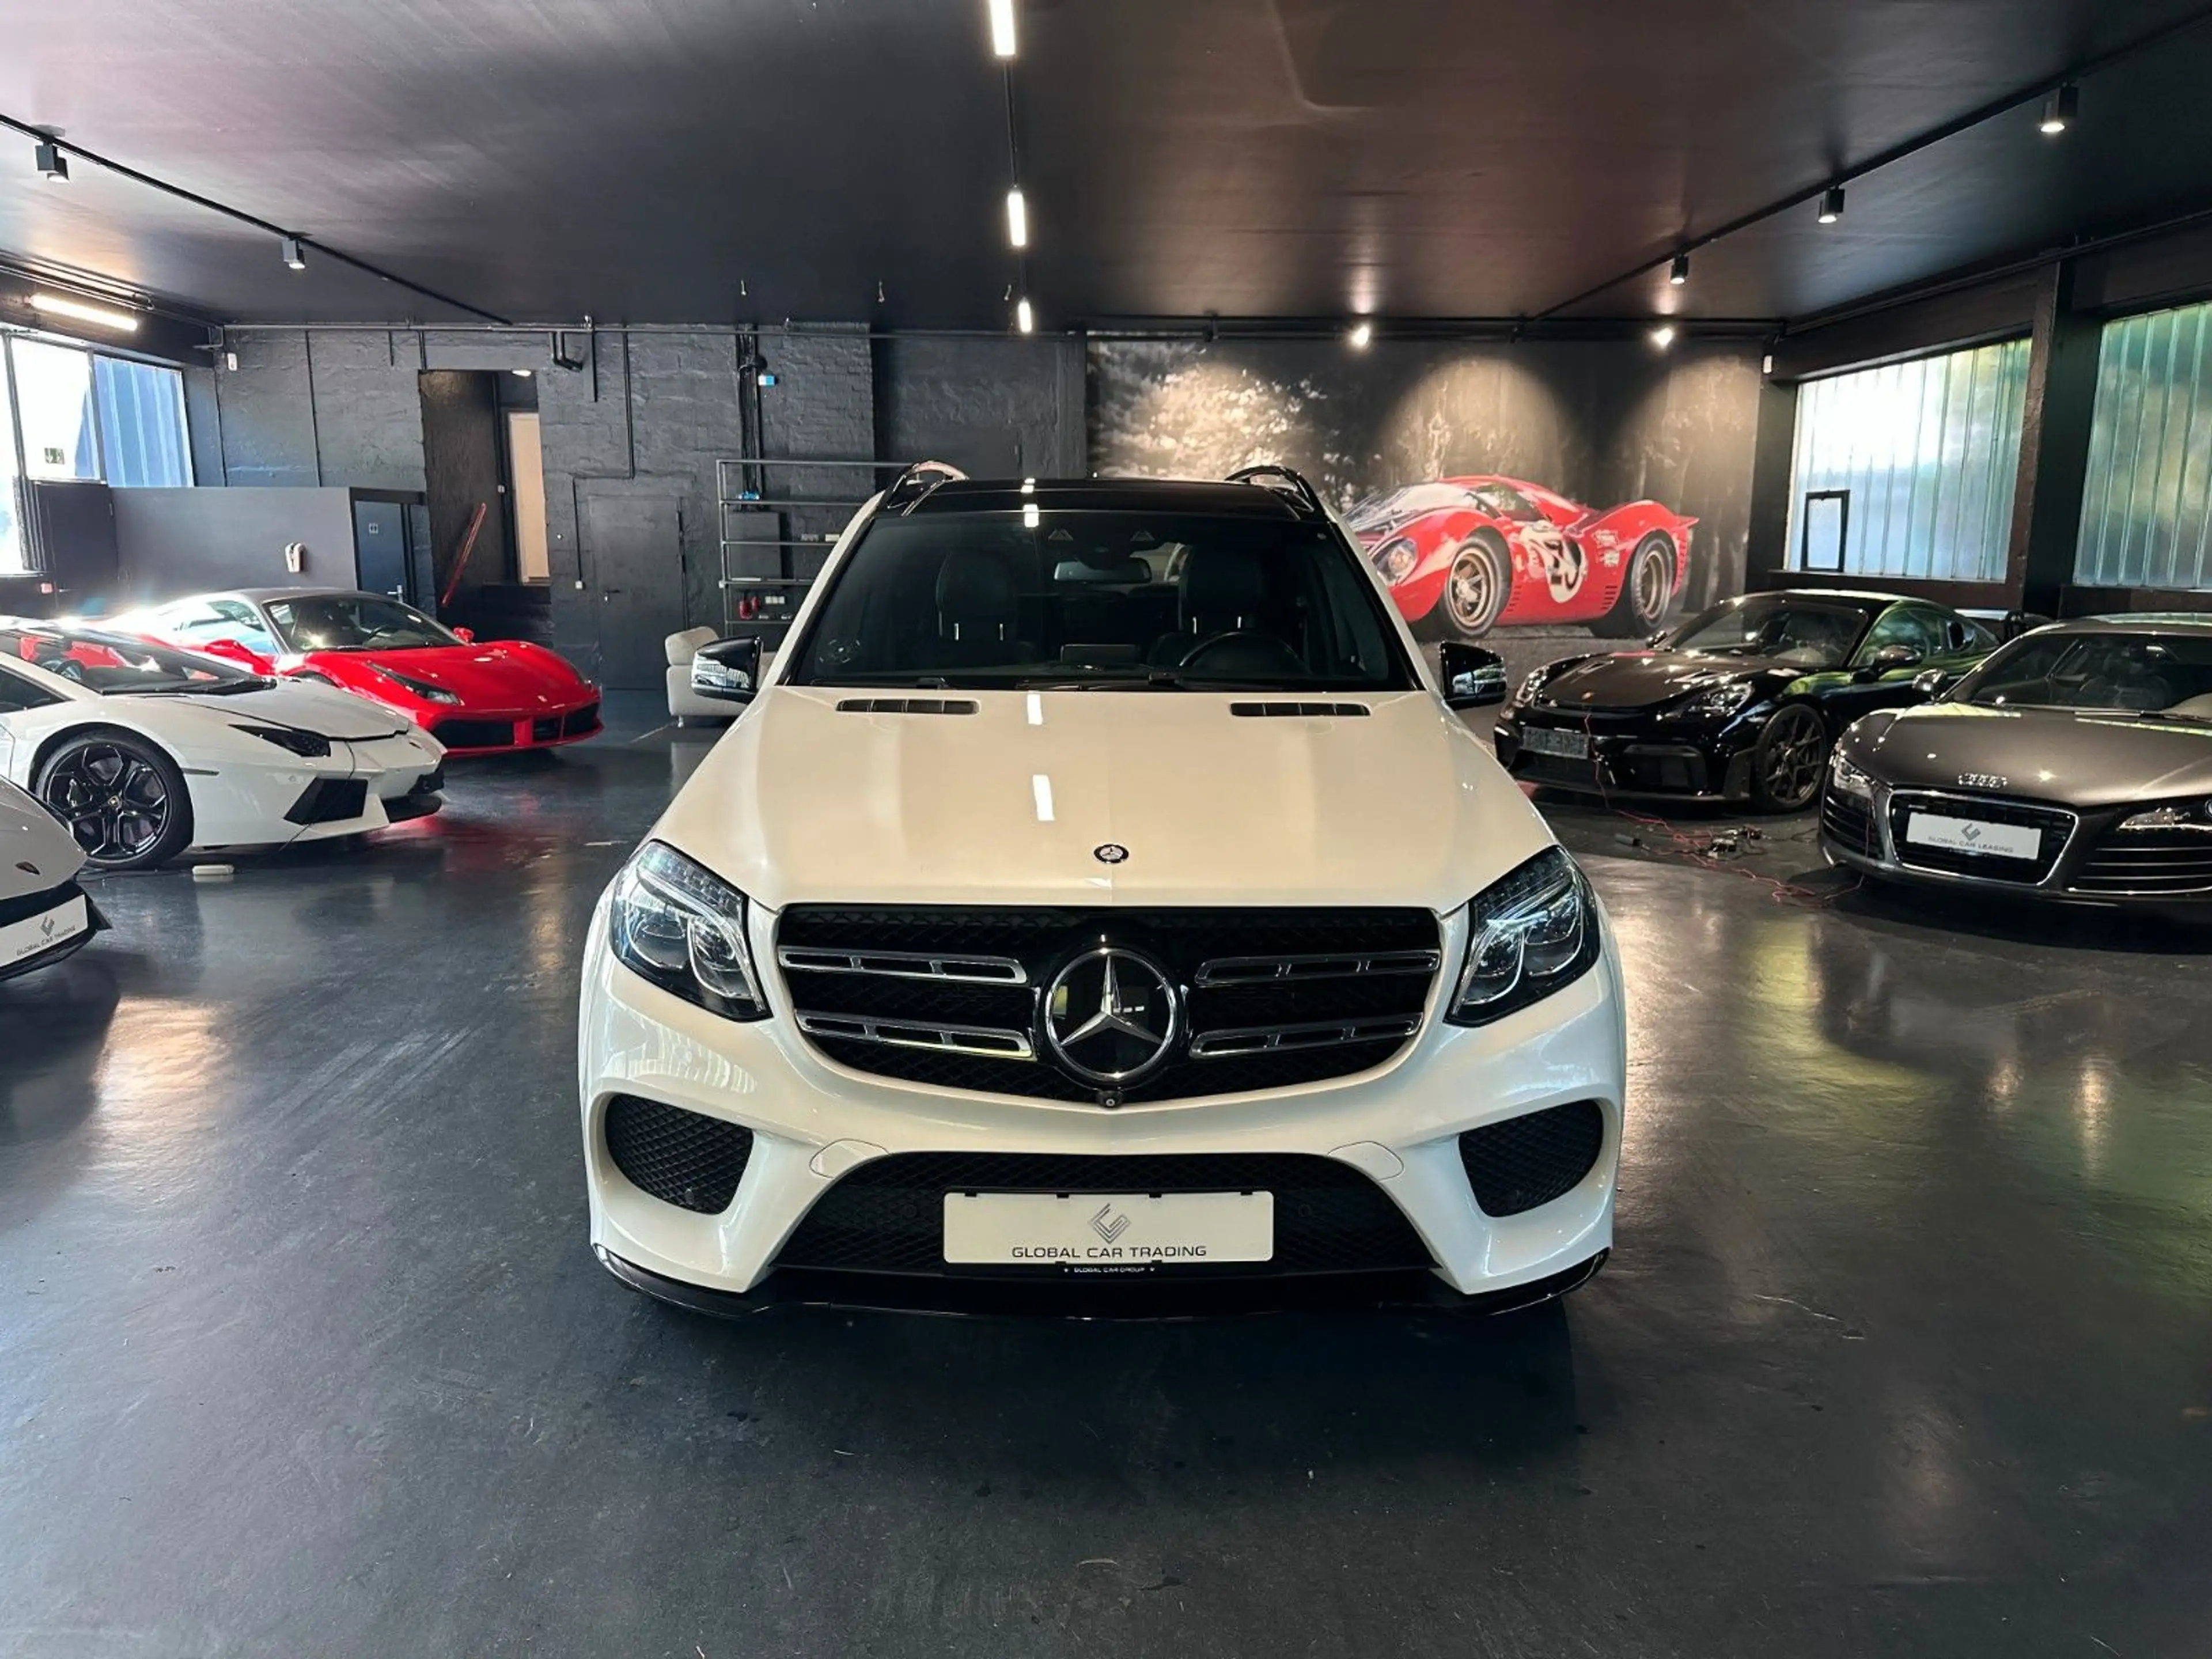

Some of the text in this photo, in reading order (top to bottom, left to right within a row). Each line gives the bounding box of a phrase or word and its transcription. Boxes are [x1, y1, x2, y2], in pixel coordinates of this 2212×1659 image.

[1929, 836, 1956, 844] GLOBAL
[1978, 843, 2014, 853] LEASING
[41, 936, 53, 945] CAR
[1012, 1245, 1207, 1258] GLOBAL CAR TRADING
